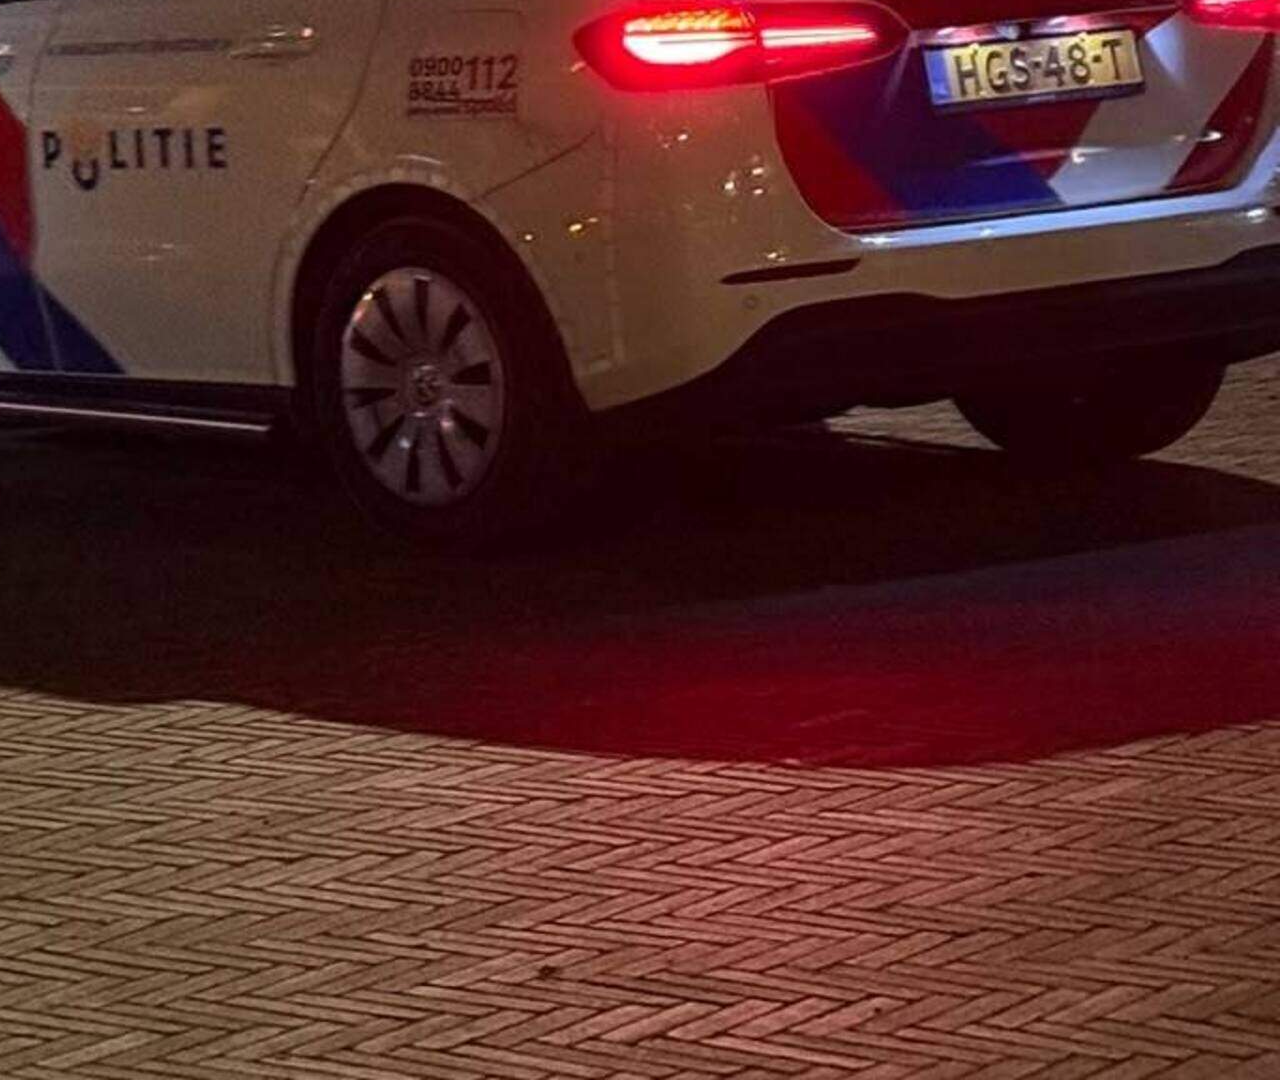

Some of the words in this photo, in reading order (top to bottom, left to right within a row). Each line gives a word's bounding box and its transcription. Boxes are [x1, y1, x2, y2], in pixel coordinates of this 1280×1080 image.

[409, 56, 462, 77] 0900
[465, 54, 518, 90] 112
[952, 38, 1123, 101] HGS-48-T
